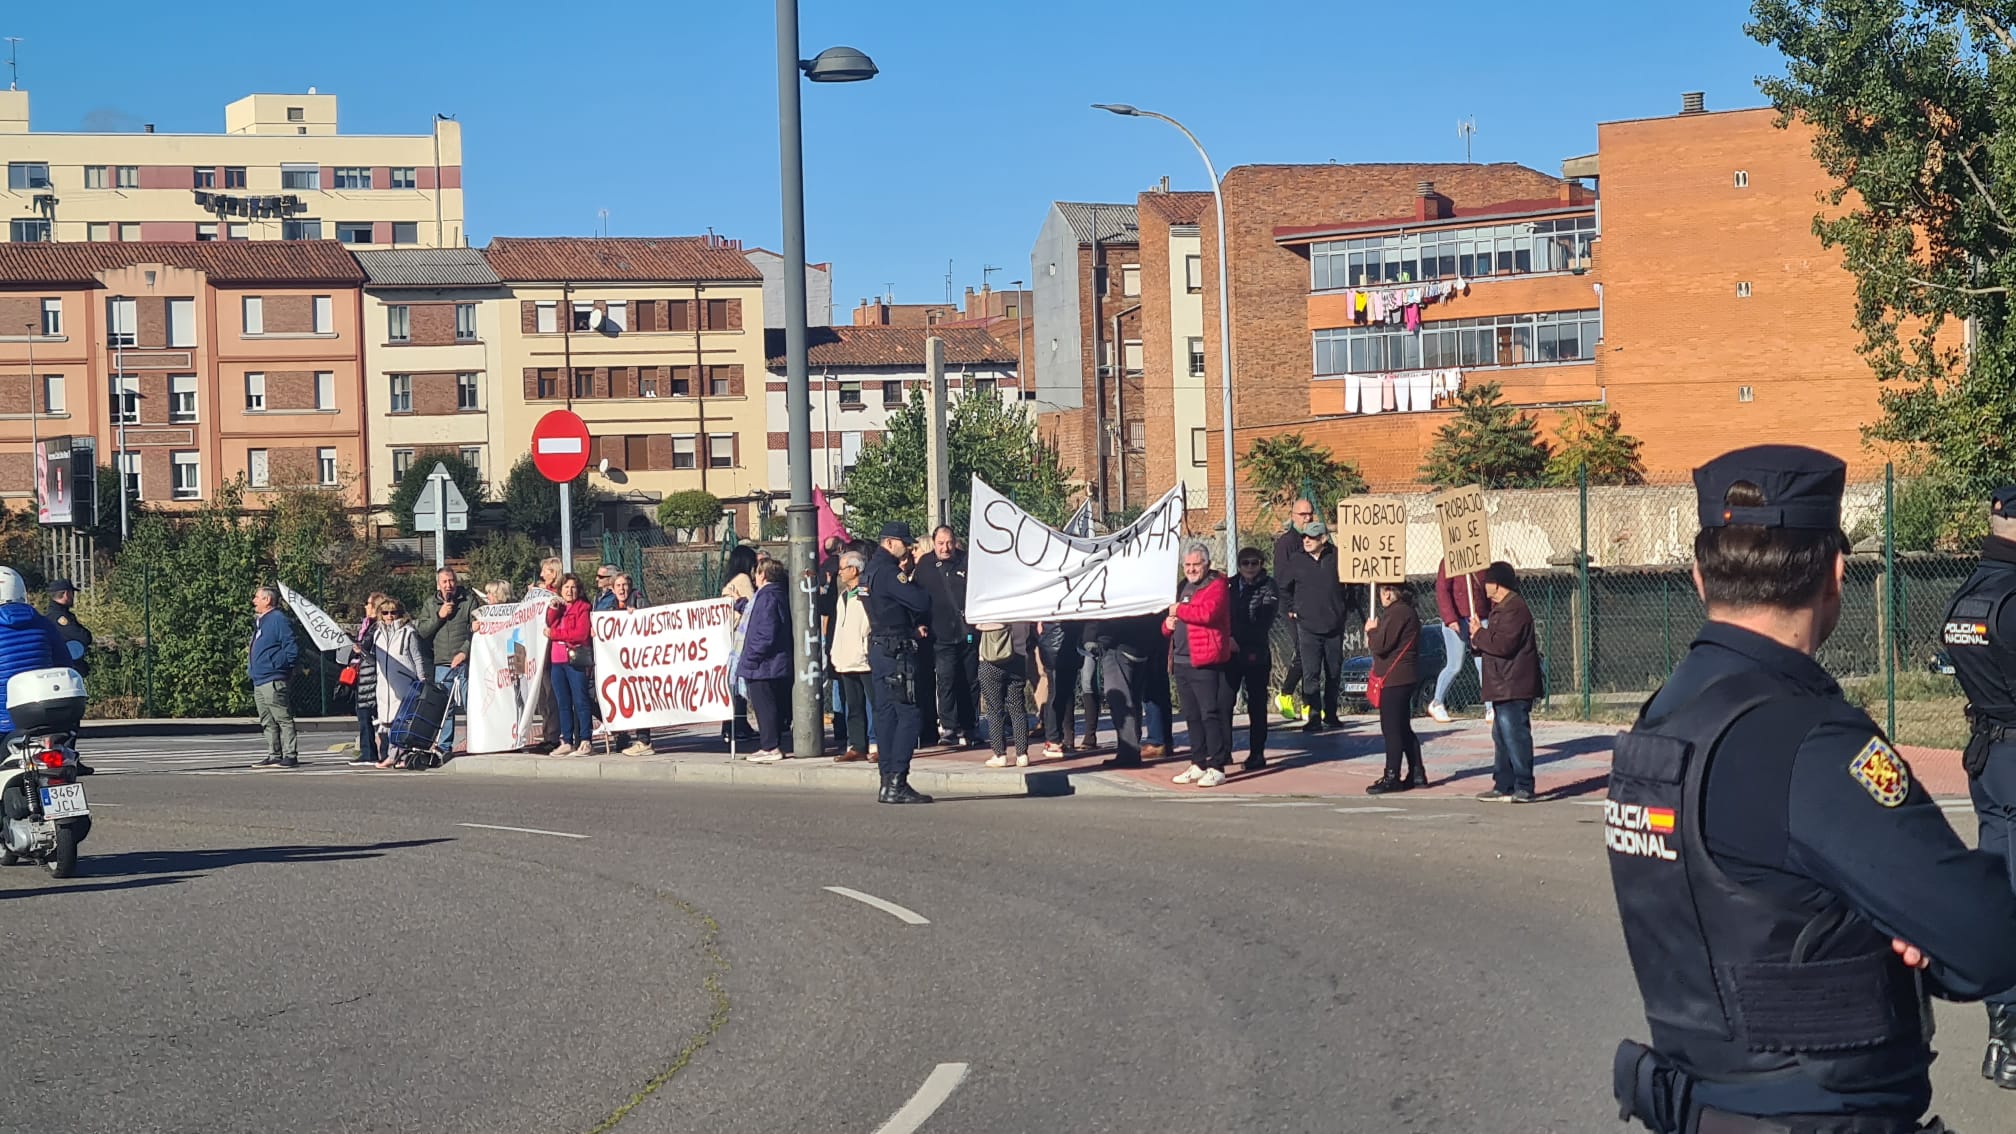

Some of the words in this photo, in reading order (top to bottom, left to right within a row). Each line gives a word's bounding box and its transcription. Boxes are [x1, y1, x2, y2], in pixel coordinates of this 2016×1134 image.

[1340, 503, 1405, 525] TROBAJO
[1436, 492, 1483, 526] TROBAJO
[1352, 534, 1370, 552] NO
[1379, 535, 1395, 552] SE
[1448, 526, 1462, 545] NO
[1467, 519, 1480, 538] SE
[1352, 556, 1402, 578] PARTE
[1449, 543, 1482, 574] RINDE
[596, 615, 628, 642] CON
[631, 609, 683, 637] NUESTROS
[1945, 623, 1976, 633] POLICIA
[619, 637, 709, 671] QUEREMOS
[601, 663, 731, 724] SOTERRAMIENTO
[51, 785, 80, 800] 3467
[55, 800, 80, 812] JCL
